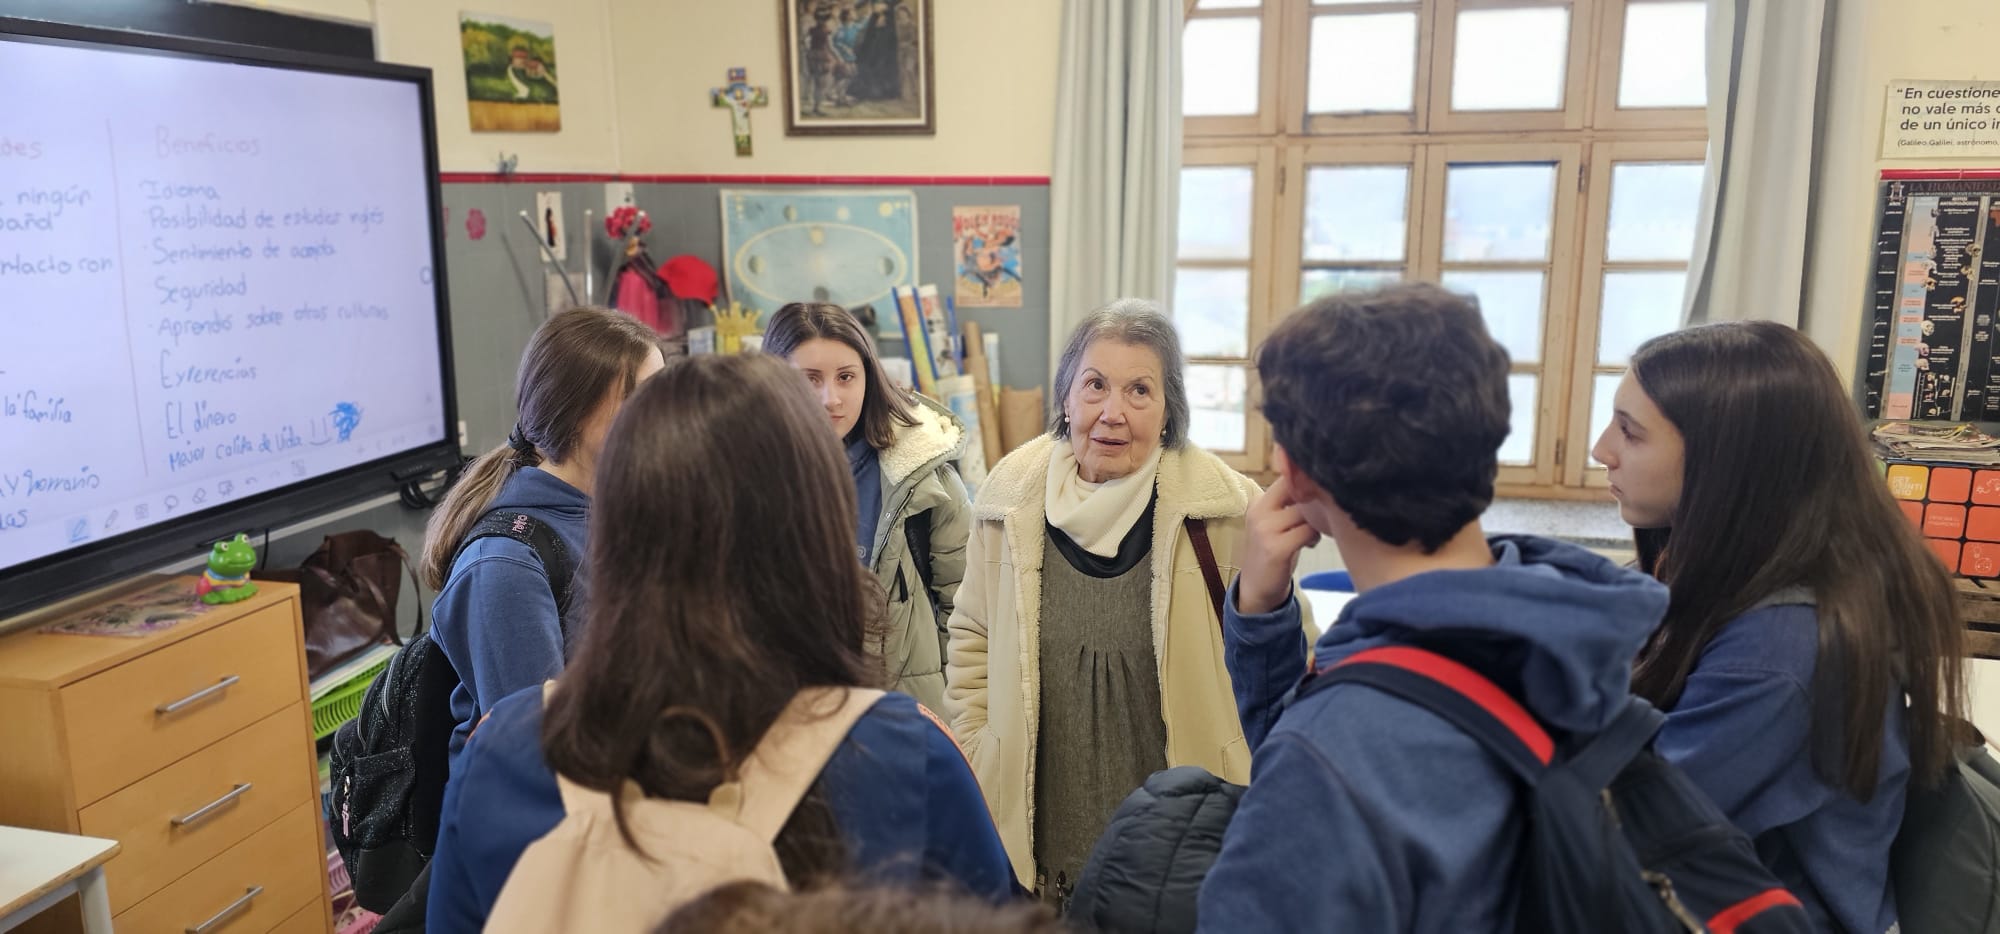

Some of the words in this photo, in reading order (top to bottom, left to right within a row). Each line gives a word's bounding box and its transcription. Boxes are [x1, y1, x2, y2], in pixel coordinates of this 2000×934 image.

[1902, 105, 1921, 115] no
[1926, 102, 1957, 115] vale
[1961, 102, 1991, 114] más
[1900, 119, 1919, 130] de
[1924, 121, 1942, 130] un
[1946, 118, 1987, 130] único
[17, 183, 91, 217] ningún
[142, 179, 221, 200] Idioma
[149, 202, 247, 229] Posibilidad
[254, 208, 275, 229] de
[262, 236, 281, 259] de
[78, 256, 114, 273] con
[154, 271, 247, 312] Seguridad
[244, 303, 284, 329] sobre
[22, 388, 73, 423] familia
[165, 401, 184, 440] El
[193, 400, 237, 433] dinero
[257, 432, 273, 454] de
